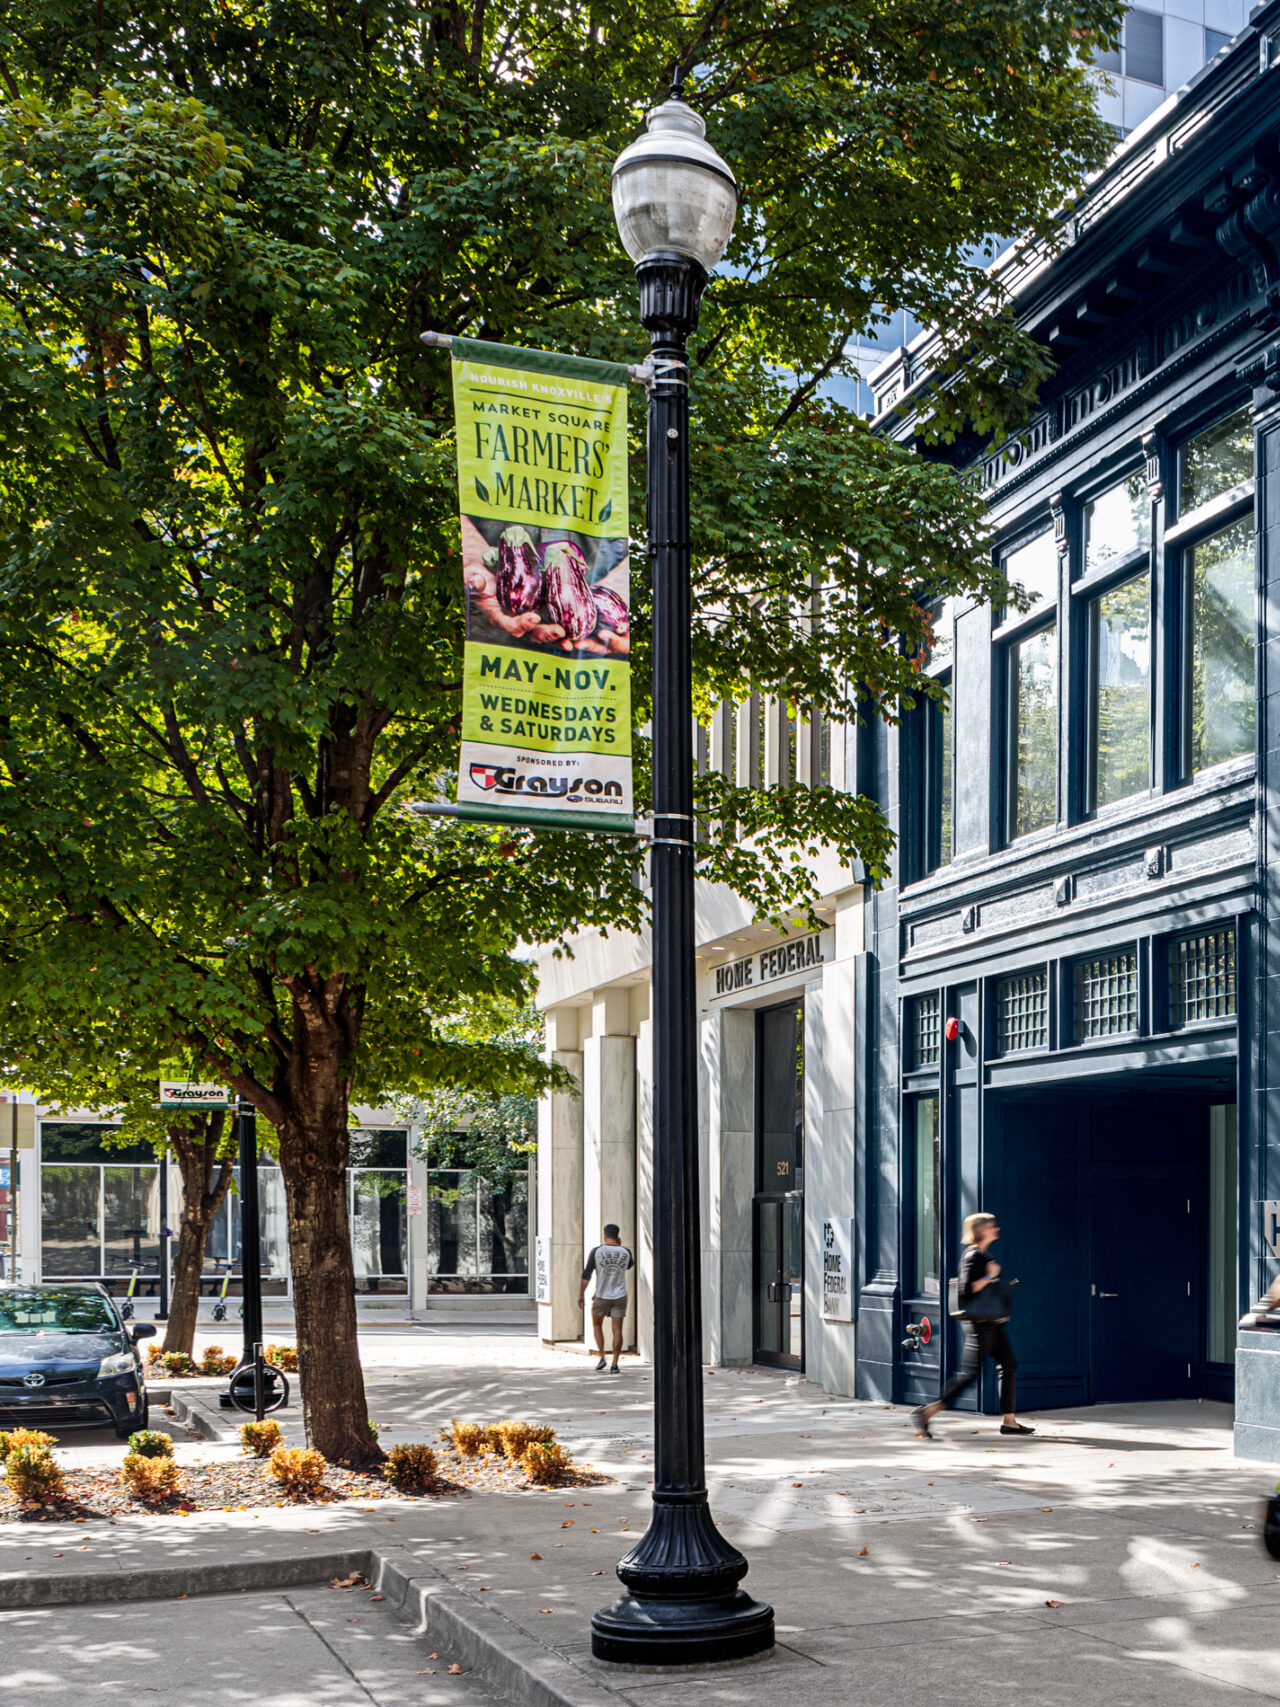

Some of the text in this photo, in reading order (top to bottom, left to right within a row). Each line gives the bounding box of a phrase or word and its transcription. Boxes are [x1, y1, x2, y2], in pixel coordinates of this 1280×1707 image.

[470, 373, 612, 405] NOURISH KNOXVILLE'S
[472, 401, 611, 433] MARKET SQUARE
[474, 421, 611, 479] FARMERS'
[495, 472, 598, 523] MARKET
[480, 693, 617, 723] WEDNESDAYS
[480, 715, 616, 744] & SATURDAYS
[516, 755, 563, 767] SPONSORED
[494, 766, 623, 798] Grayson
[584, 796, 623, 805] SUBARU
[716, 935, 825, 994] HOME FEDERAL
[174, 1089, 224, 1099] Grayson
[776, 1161, 789, 1176] 521
